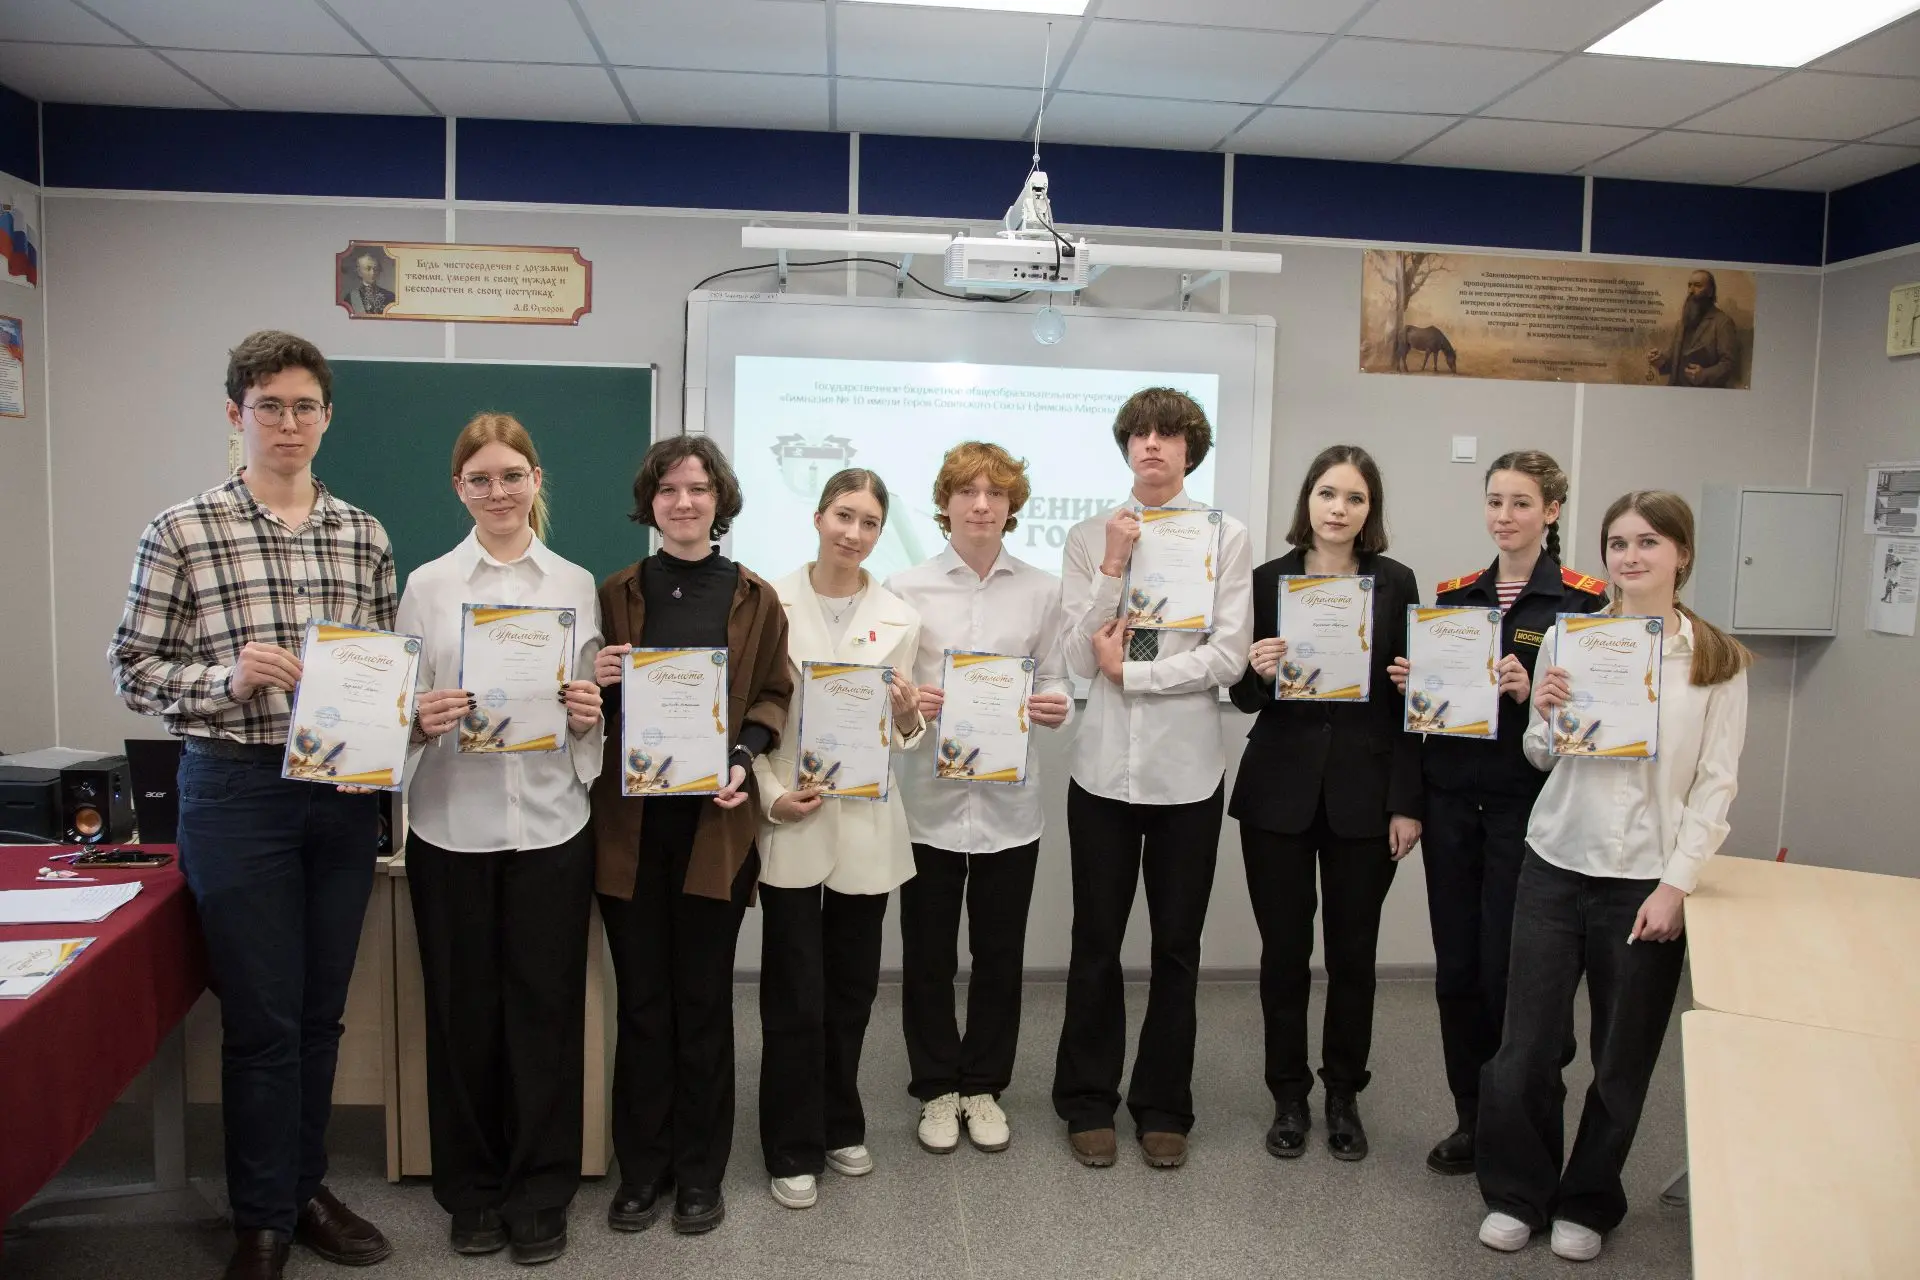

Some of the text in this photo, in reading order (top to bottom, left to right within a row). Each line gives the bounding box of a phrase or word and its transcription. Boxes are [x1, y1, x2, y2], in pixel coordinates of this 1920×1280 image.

[416, 259, 440, 270] Будь
[444, 262, 512, 272] чистосердечен
[523, 264, 569, 273] друзьями
[447, 274, 481, 284] умерен
[493, 276, 519, 285] своих
[522, 277, 557, 286] нуждах
[405, 285, 464, 294] бескорыстен
[477, 288, 502, 297] своих
[814, 381, 901, 393] Государственное
[1018, 496, 1117, 520] ЕНИК
[1025, 524, 1066, 548] ГО
[1300, 590, 1352, 609] Грамота
[488, 623, 551, 647] Грамота
[1429, 621, 1480, 640] Грамота
[1578, 631, 1638, 653] Грамота
[331, 644, 394, 671] Грамота
[647, 664, 704, 686] Грамота
[964, 667, 1014, 688] Грамота
[824, 678, 875, 700] Грамота
